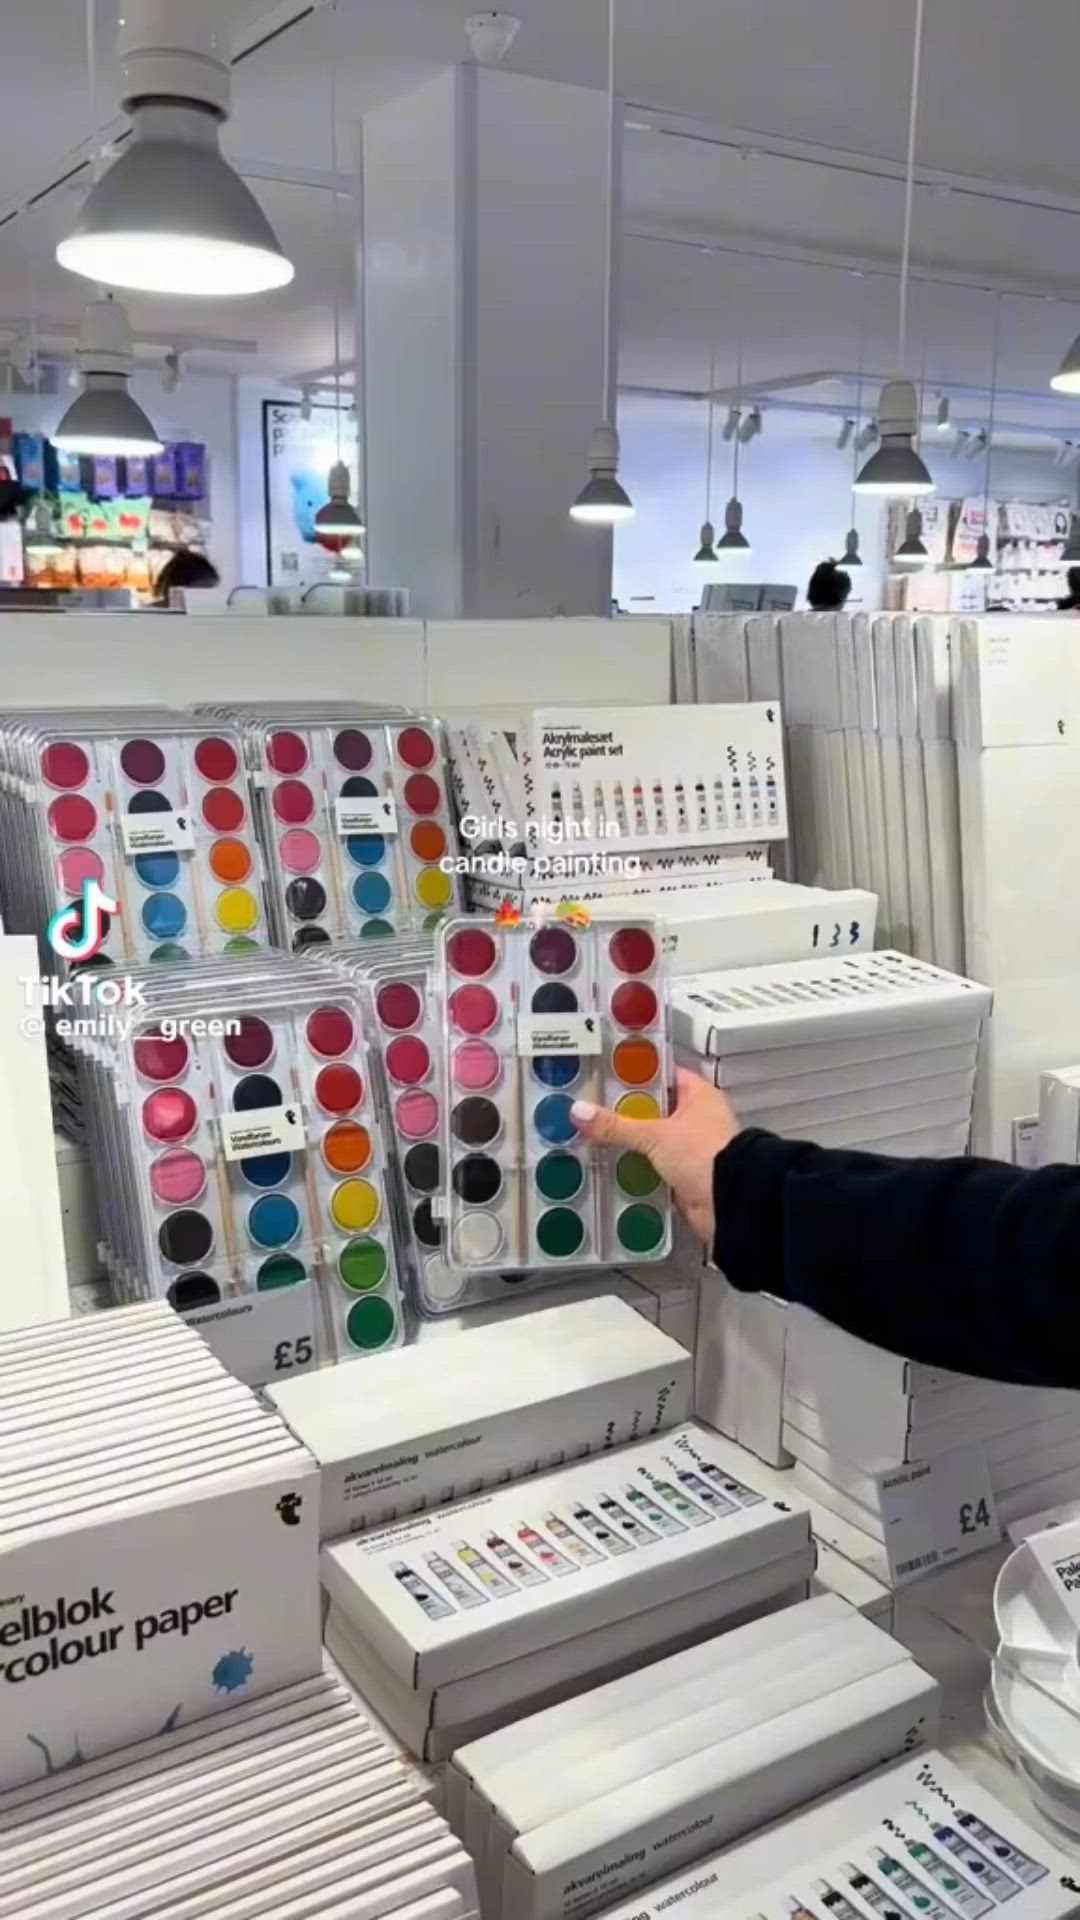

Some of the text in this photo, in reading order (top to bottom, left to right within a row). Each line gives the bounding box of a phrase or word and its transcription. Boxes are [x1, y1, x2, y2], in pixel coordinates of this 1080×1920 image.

[543, 745, 623, 761] Acrylic paint set
[274, 1336, 313, 1371] £5
[959, 1497, 991, 1535] £4
[135, 1588, 239, 1651] paper
[654, 1873, 719, 1912] watercolour
